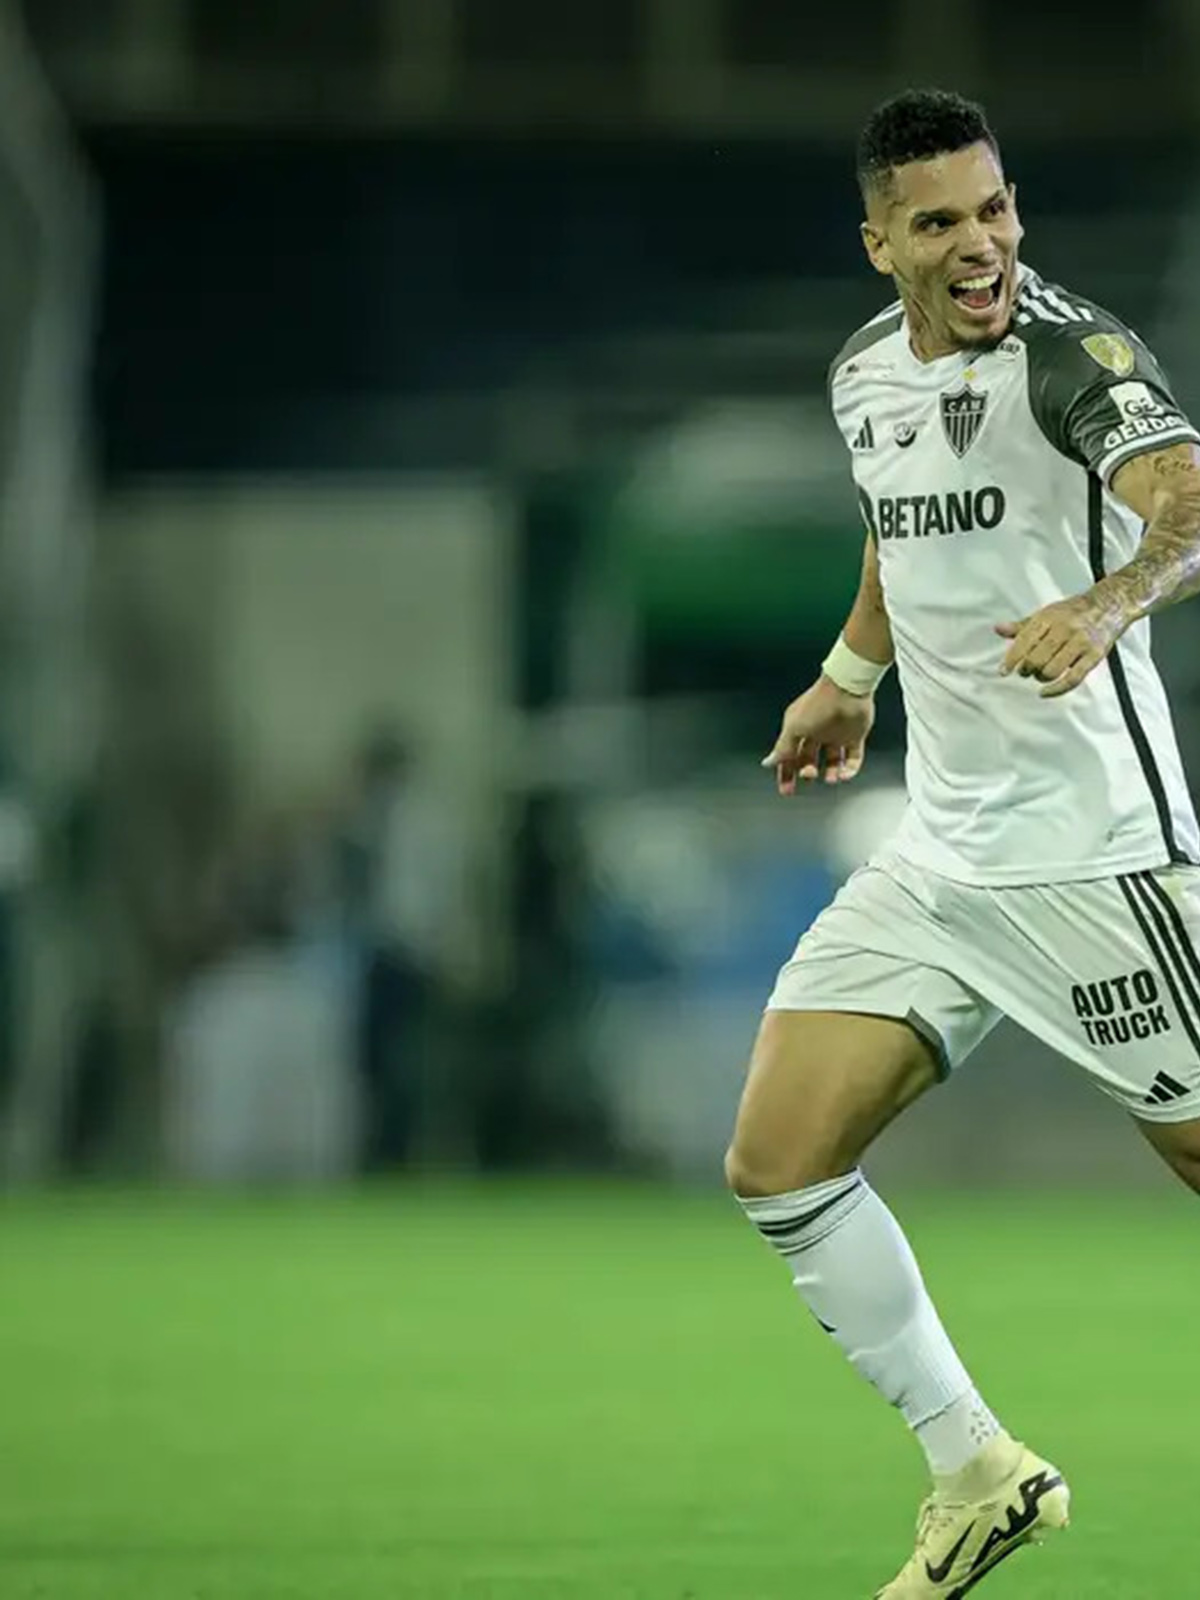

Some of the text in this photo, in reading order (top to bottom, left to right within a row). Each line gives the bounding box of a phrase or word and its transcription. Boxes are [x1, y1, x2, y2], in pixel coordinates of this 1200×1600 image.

[947, 400, 982, 412] CAM
[1103, 415, 1187, 449] GERDA
[878, 486, 1006, 540] BETANO
[1071, 969, 1159, 1018] AUTO
[1081, 1004, 1171, 1046] TRUCK
